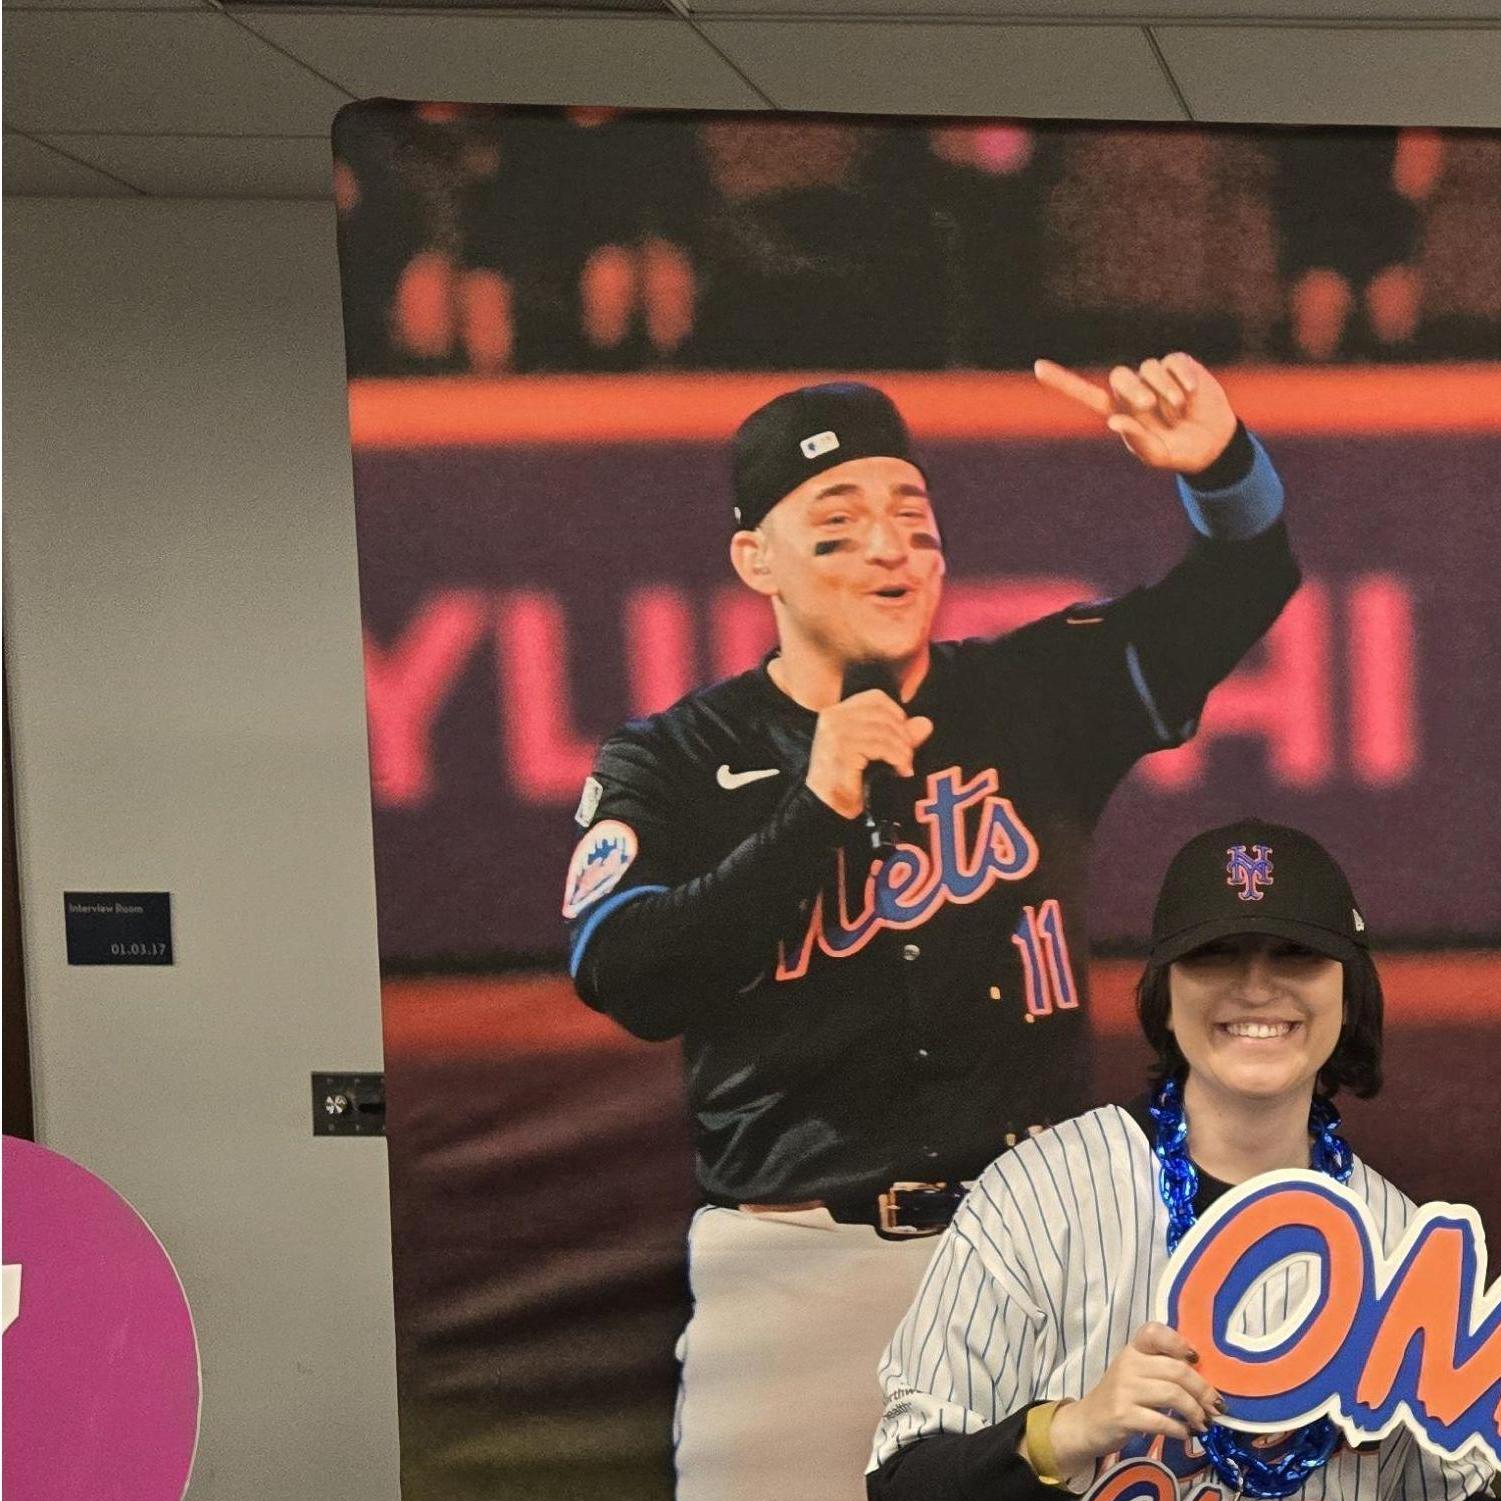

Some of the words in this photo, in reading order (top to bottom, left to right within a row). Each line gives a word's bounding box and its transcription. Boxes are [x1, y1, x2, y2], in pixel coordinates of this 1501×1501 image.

[69, 901, 114, 913] Interview
[115, 902, 144, 913] Room
[111, 943, 166, 956] 01.03.17
[1011, 899, 1079, 1015] 11
